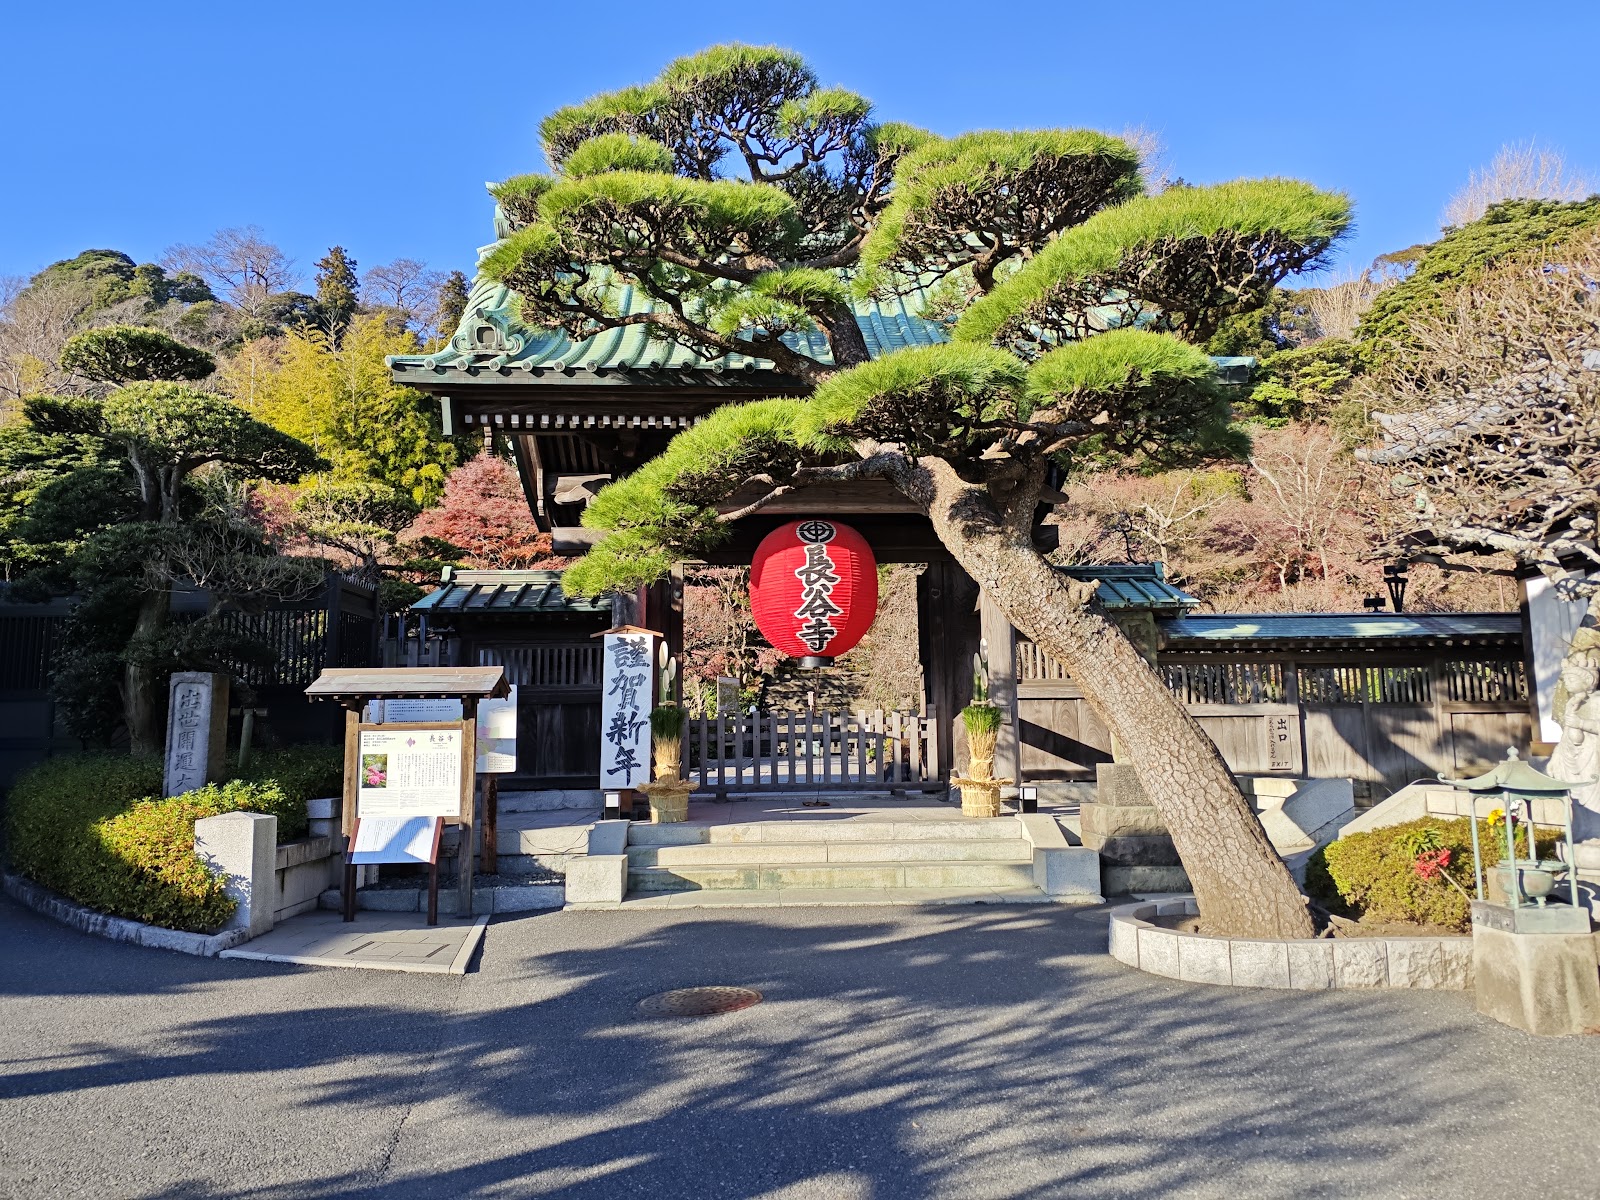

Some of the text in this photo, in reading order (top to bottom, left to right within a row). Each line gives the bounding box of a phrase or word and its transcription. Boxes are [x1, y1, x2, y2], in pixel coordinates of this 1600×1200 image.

[796, 544, 841, 652] 長谷寺
[172, 689, 200, 797] 出世開運大
[606, 636, 650, 786] 謹賀新年
[1277, 718, 1287, 742] 出口
